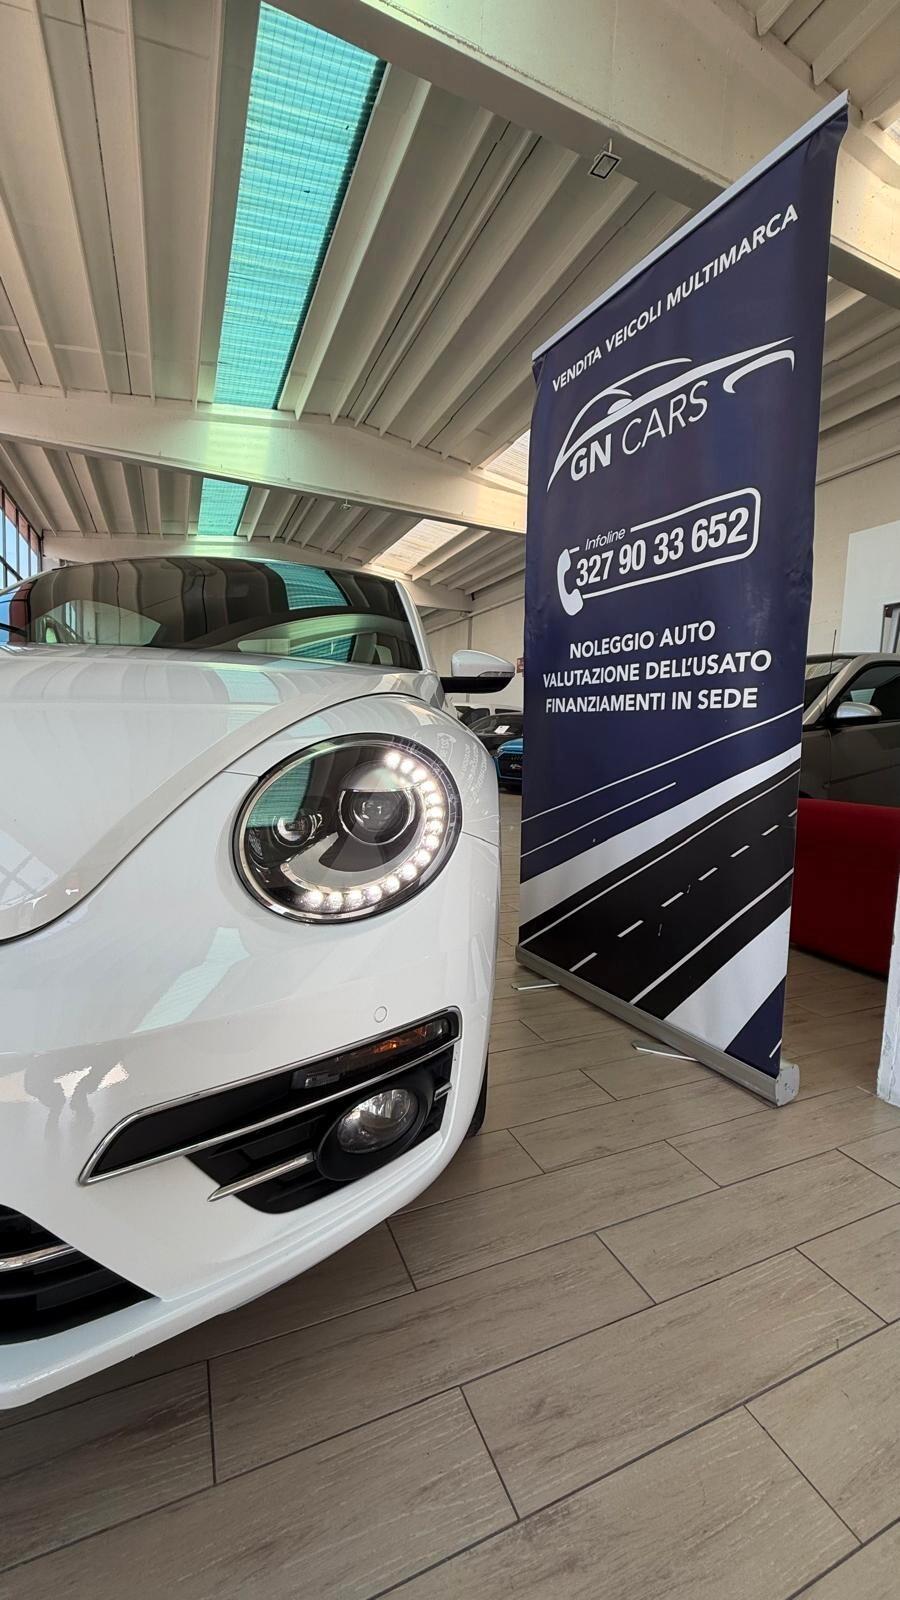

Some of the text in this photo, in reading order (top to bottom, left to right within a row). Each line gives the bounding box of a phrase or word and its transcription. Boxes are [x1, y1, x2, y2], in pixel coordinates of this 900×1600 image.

[552, 204, 799, 392] VENDITA VEICOLI MULTIMARCA
[570, 380, 709, 482] GN CARS
[575, 506, 749, 587] 327 90 33 652
[585, 527, 626, 551] Infoline
[569, 620, 716, 659] NOLEGGIO AUTO
[542, 663, 640, 688] VALUTAZIONE
[545, 687, 758, 713] FINANZIAMENTI IN SEDE
